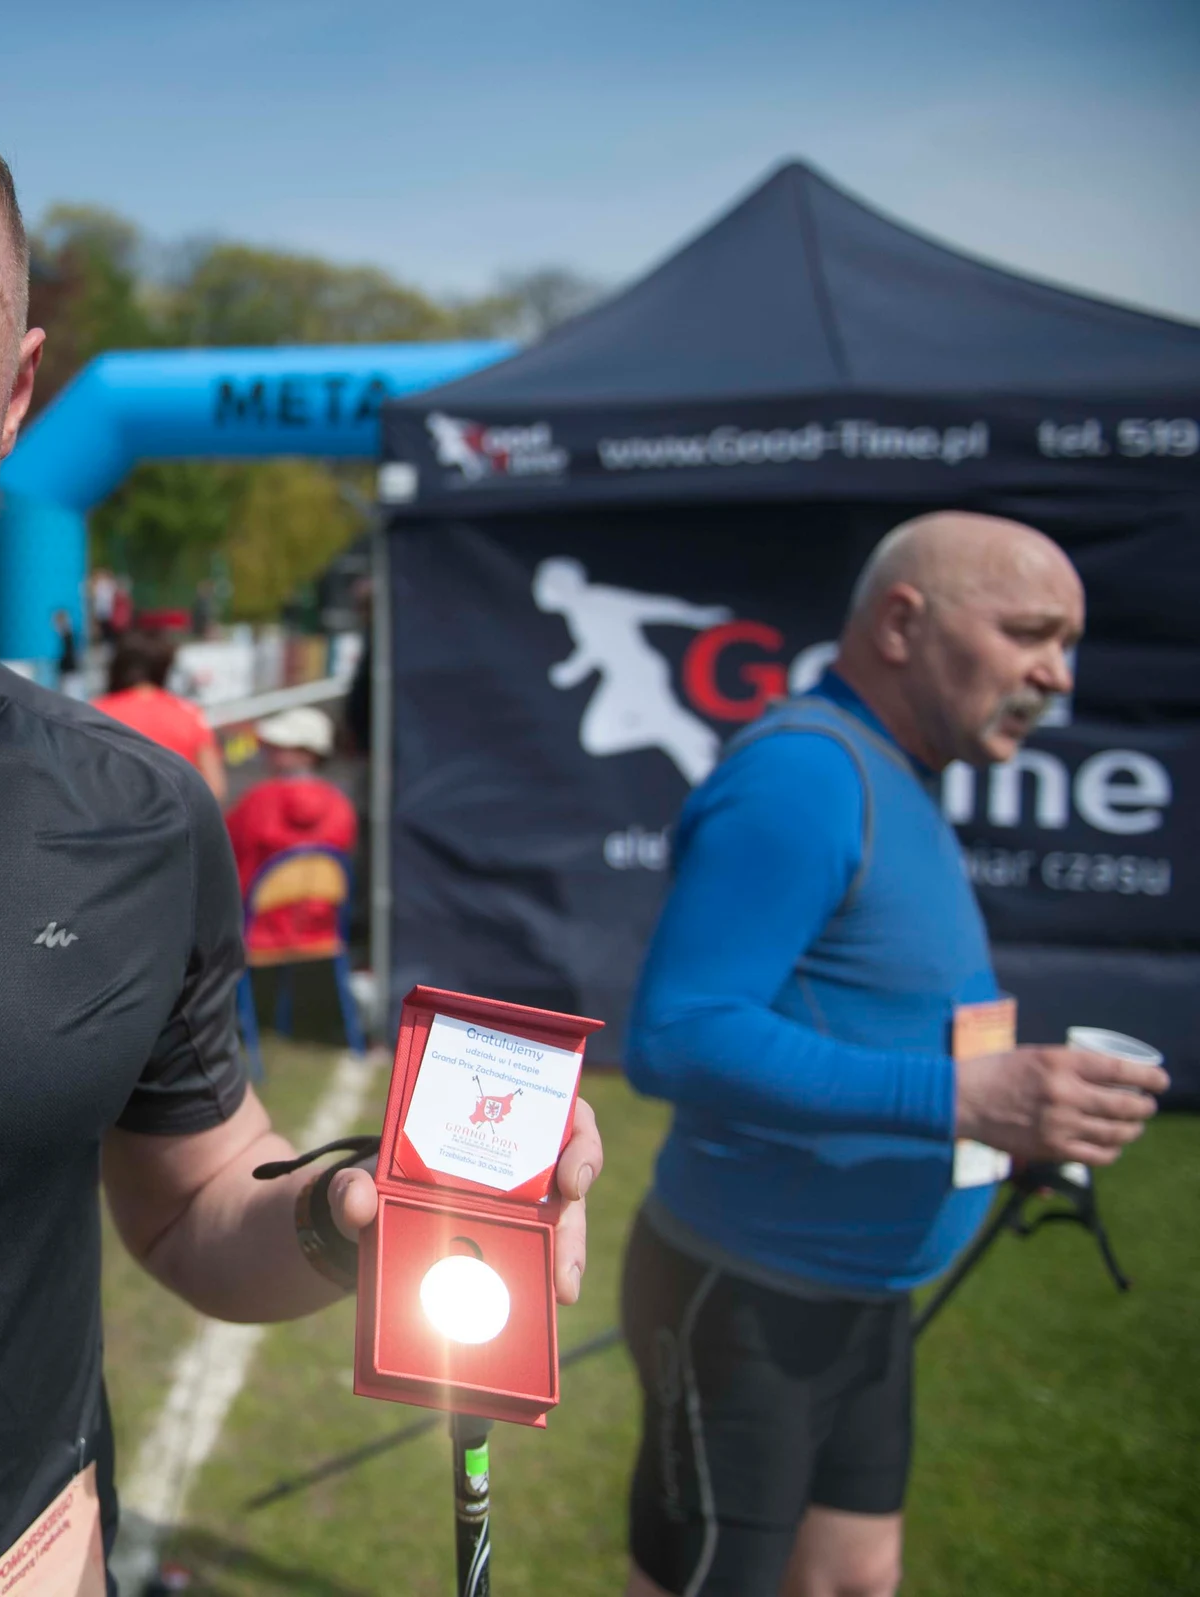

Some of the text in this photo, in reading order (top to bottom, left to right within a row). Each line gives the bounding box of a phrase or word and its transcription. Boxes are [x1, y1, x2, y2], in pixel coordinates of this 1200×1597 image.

[214, 377, 384, 428] META
[598, 419, 989, 469] www.Good-Time.pl
[1041, 851, 1172, 895] czasu
[431, 1050, 456, 1065] Grand
[466, 1027, 544, 1061] Gratulujemy
[513, 1061, 540, 1075] etapie
[445, 1122, 486, 1140] GRAND
